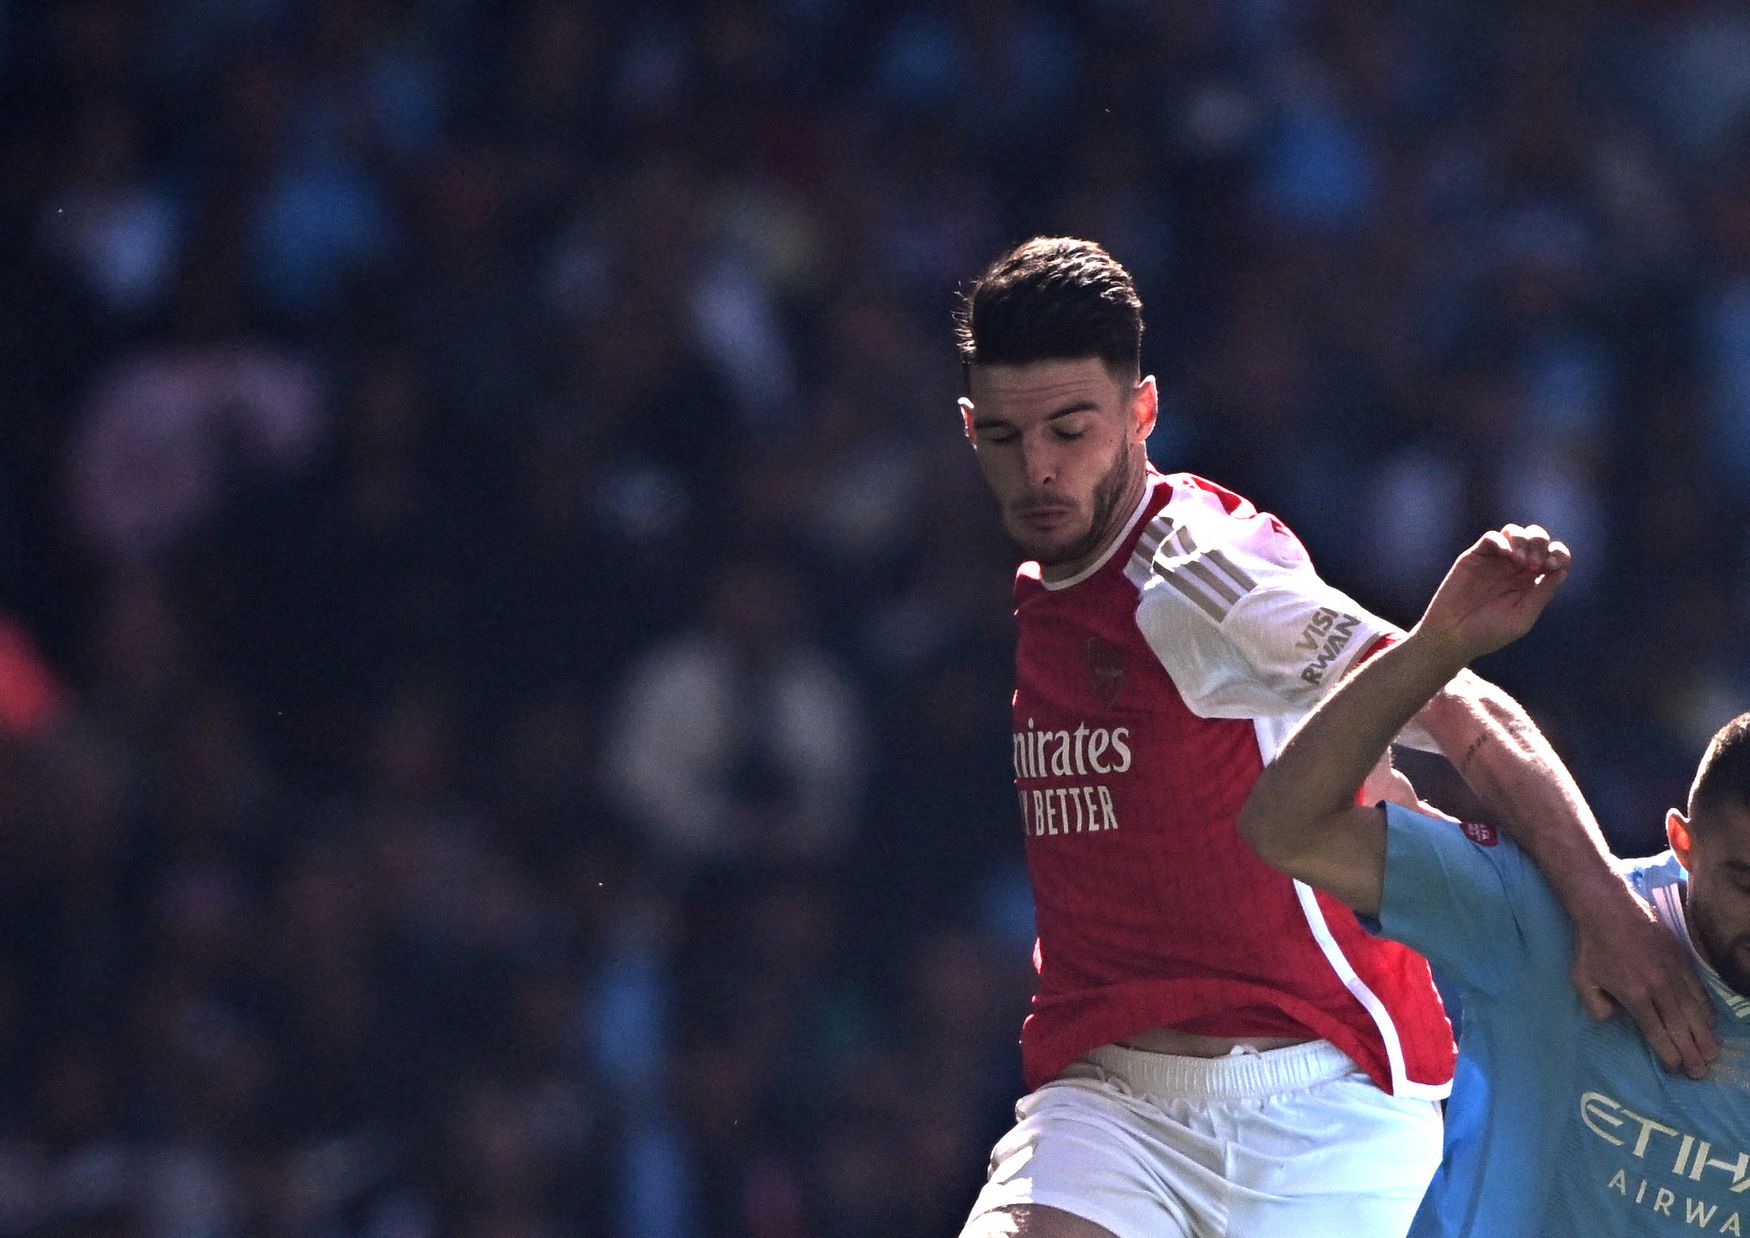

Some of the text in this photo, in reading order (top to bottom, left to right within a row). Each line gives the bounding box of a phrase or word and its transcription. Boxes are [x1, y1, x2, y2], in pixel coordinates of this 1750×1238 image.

[1294, 606, 1339, 651] VISI
[1301, 612, 1362, 685] RWAN
[1013, 717, 1132, 778] mirates
[1033, 785, 1119, 836] BETTER
